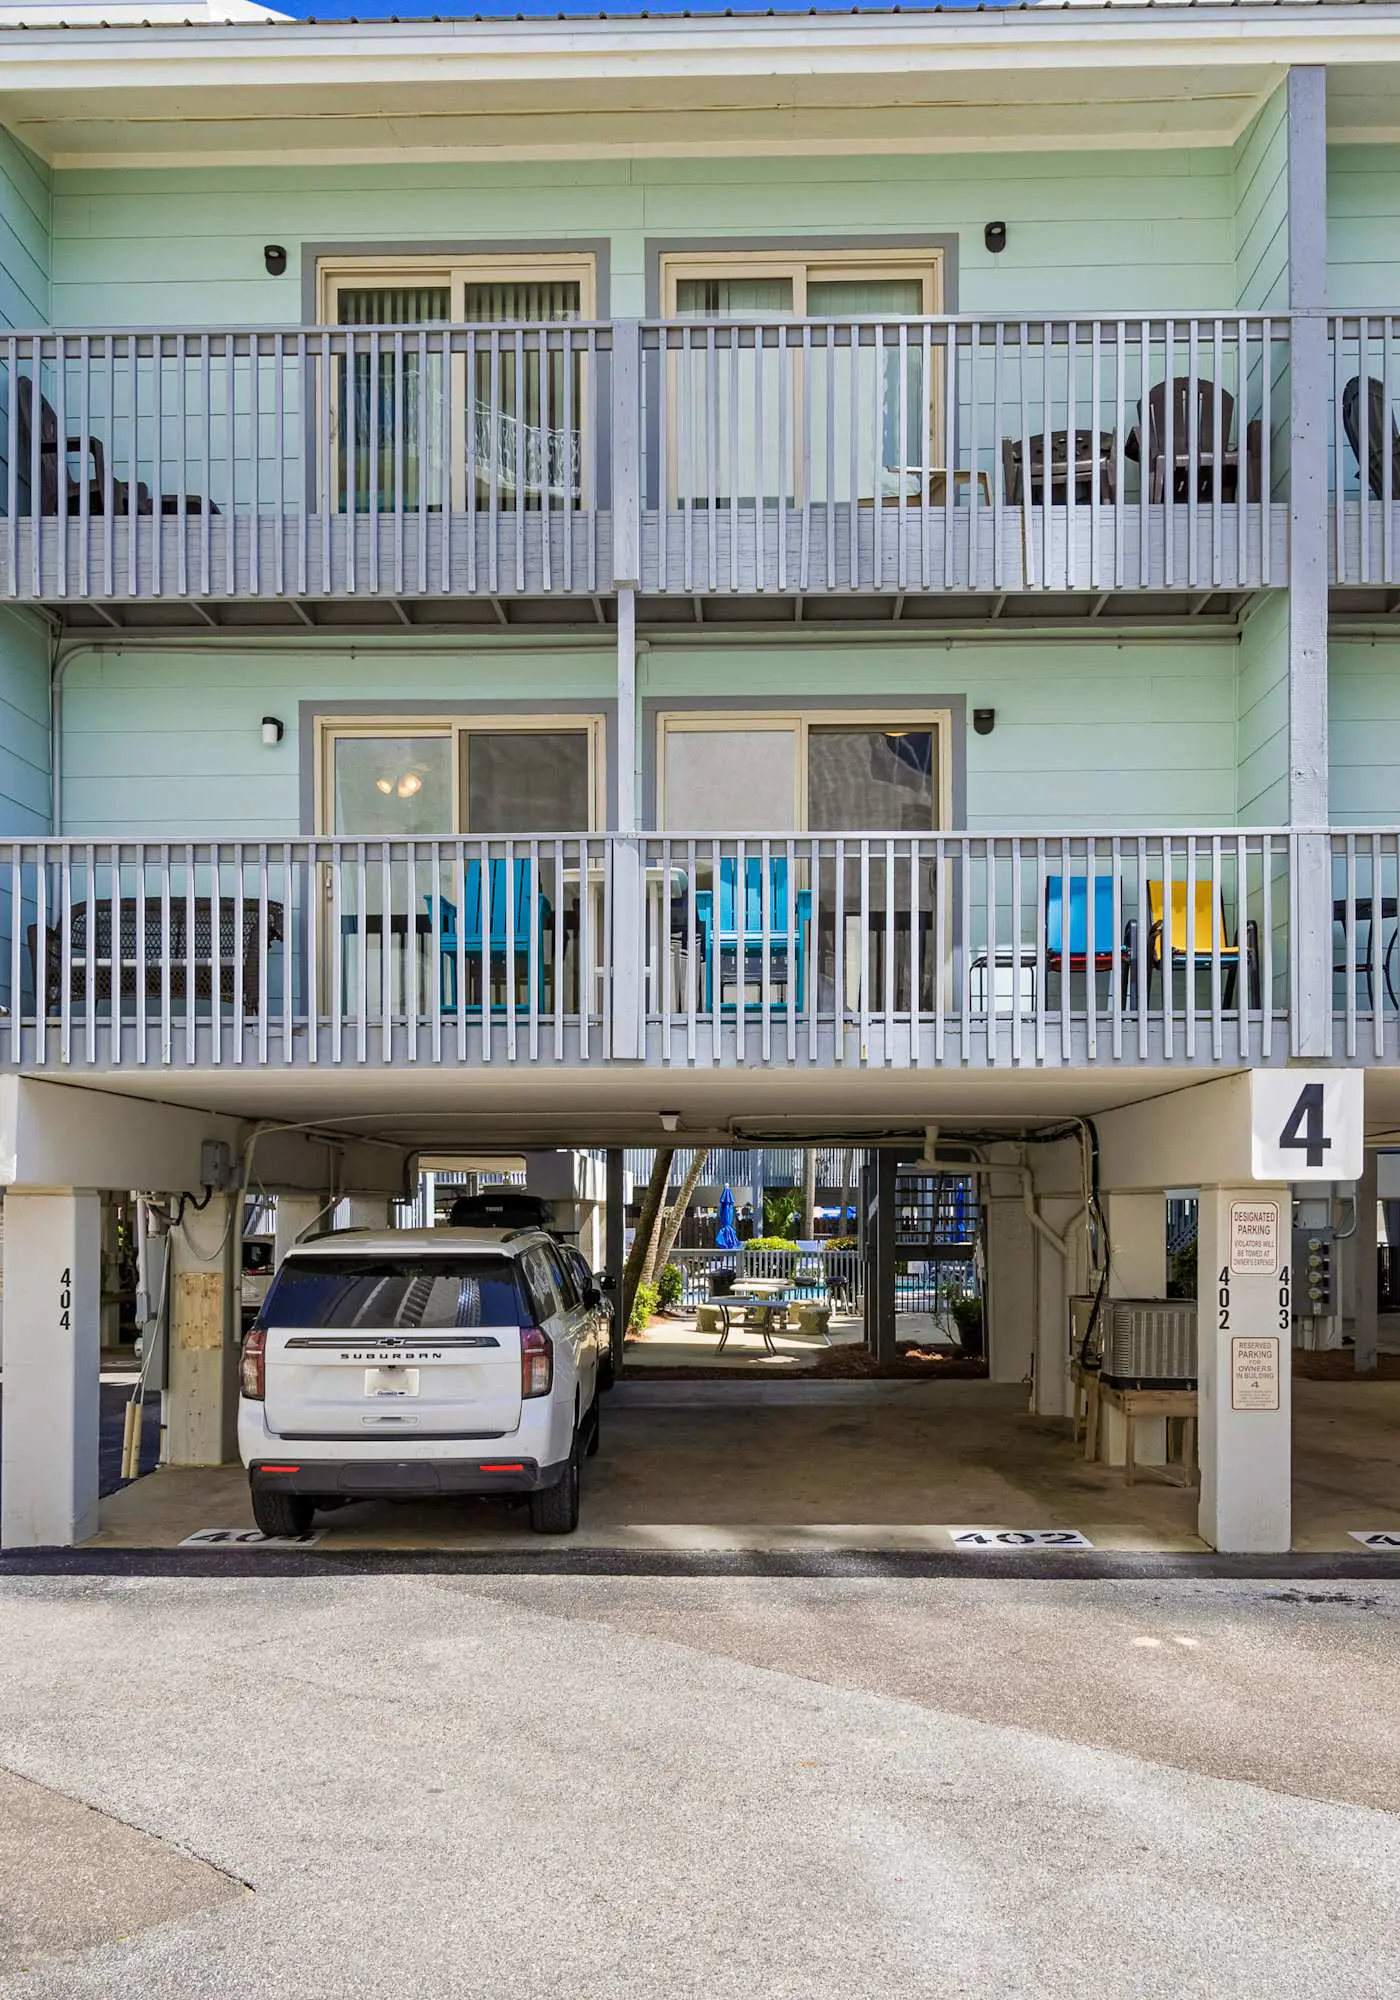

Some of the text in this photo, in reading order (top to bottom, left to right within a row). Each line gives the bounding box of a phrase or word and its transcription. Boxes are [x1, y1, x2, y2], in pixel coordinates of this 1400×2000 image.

[1279, 1083, 1332, 1167] 4
[1234, 1211, 1275, 1222] DESIGNATED
[1238, 1225, 1271, 1235] PARKING
[60, 1268, 71, 1330] 404
[1219, 1266, 1230, 1329] 402
[1279, 1266, 1290, 1329] 403
[1238, 1350, 1273, 1358] PARKING
[954, 1532, 1083, 1545] 402
